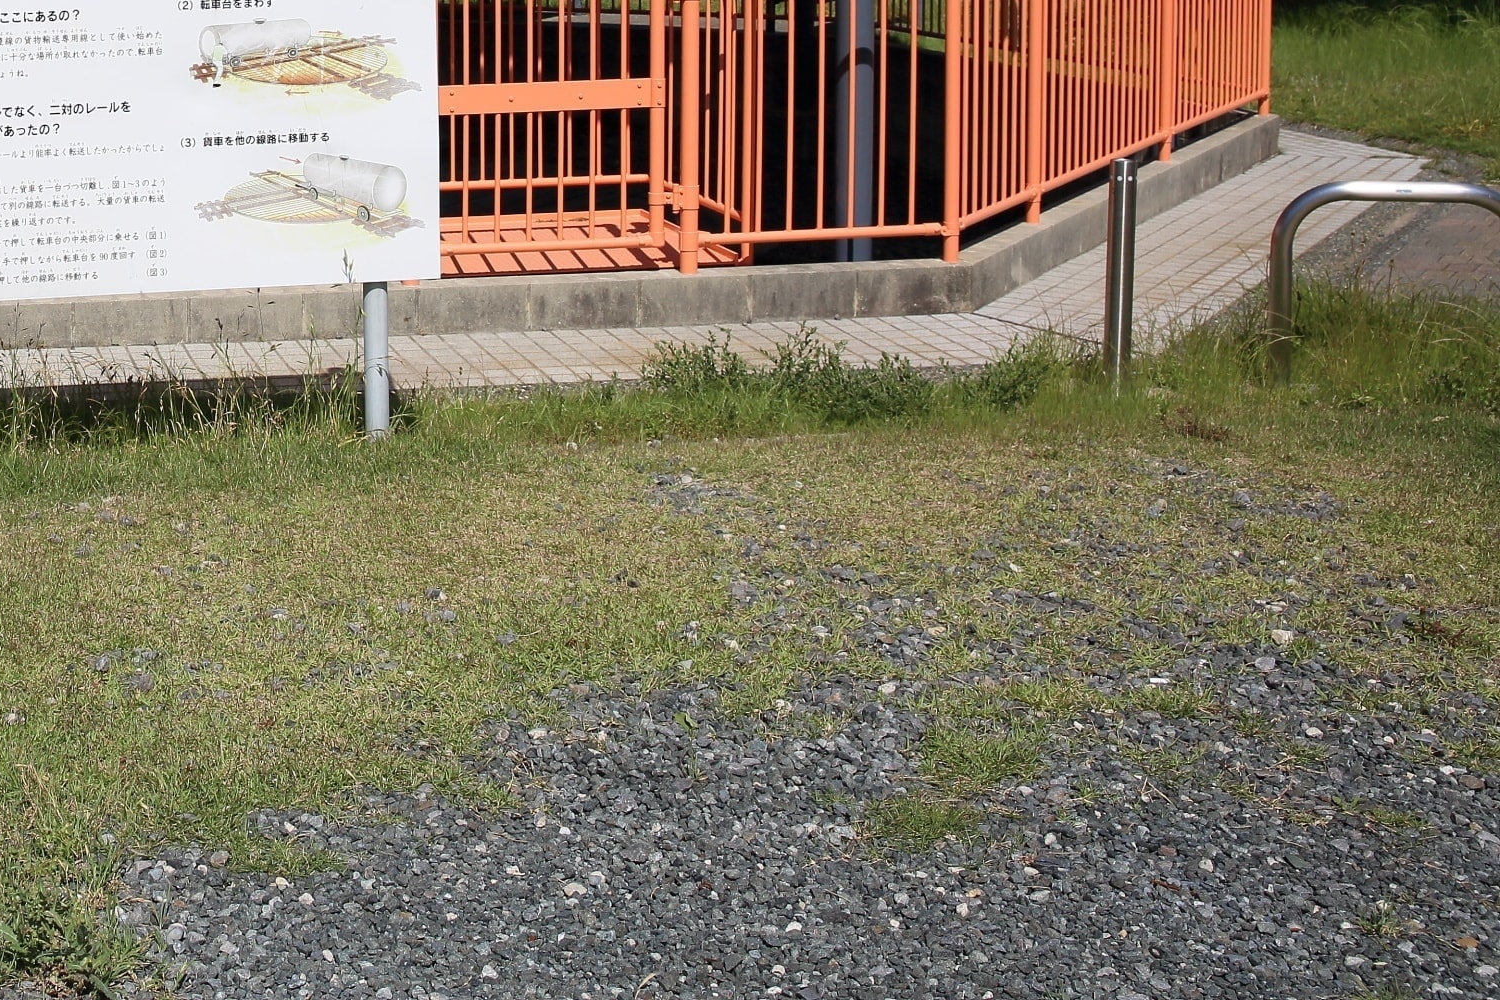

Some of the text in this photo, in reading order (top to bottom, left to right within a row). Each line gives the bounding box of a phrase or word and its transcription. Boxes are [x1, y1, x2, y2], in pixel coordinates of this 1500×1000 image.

[178, 0, 194, 11] (2)
[181, 132, 329, 148] (3) 貨車を他の線路に移動する
